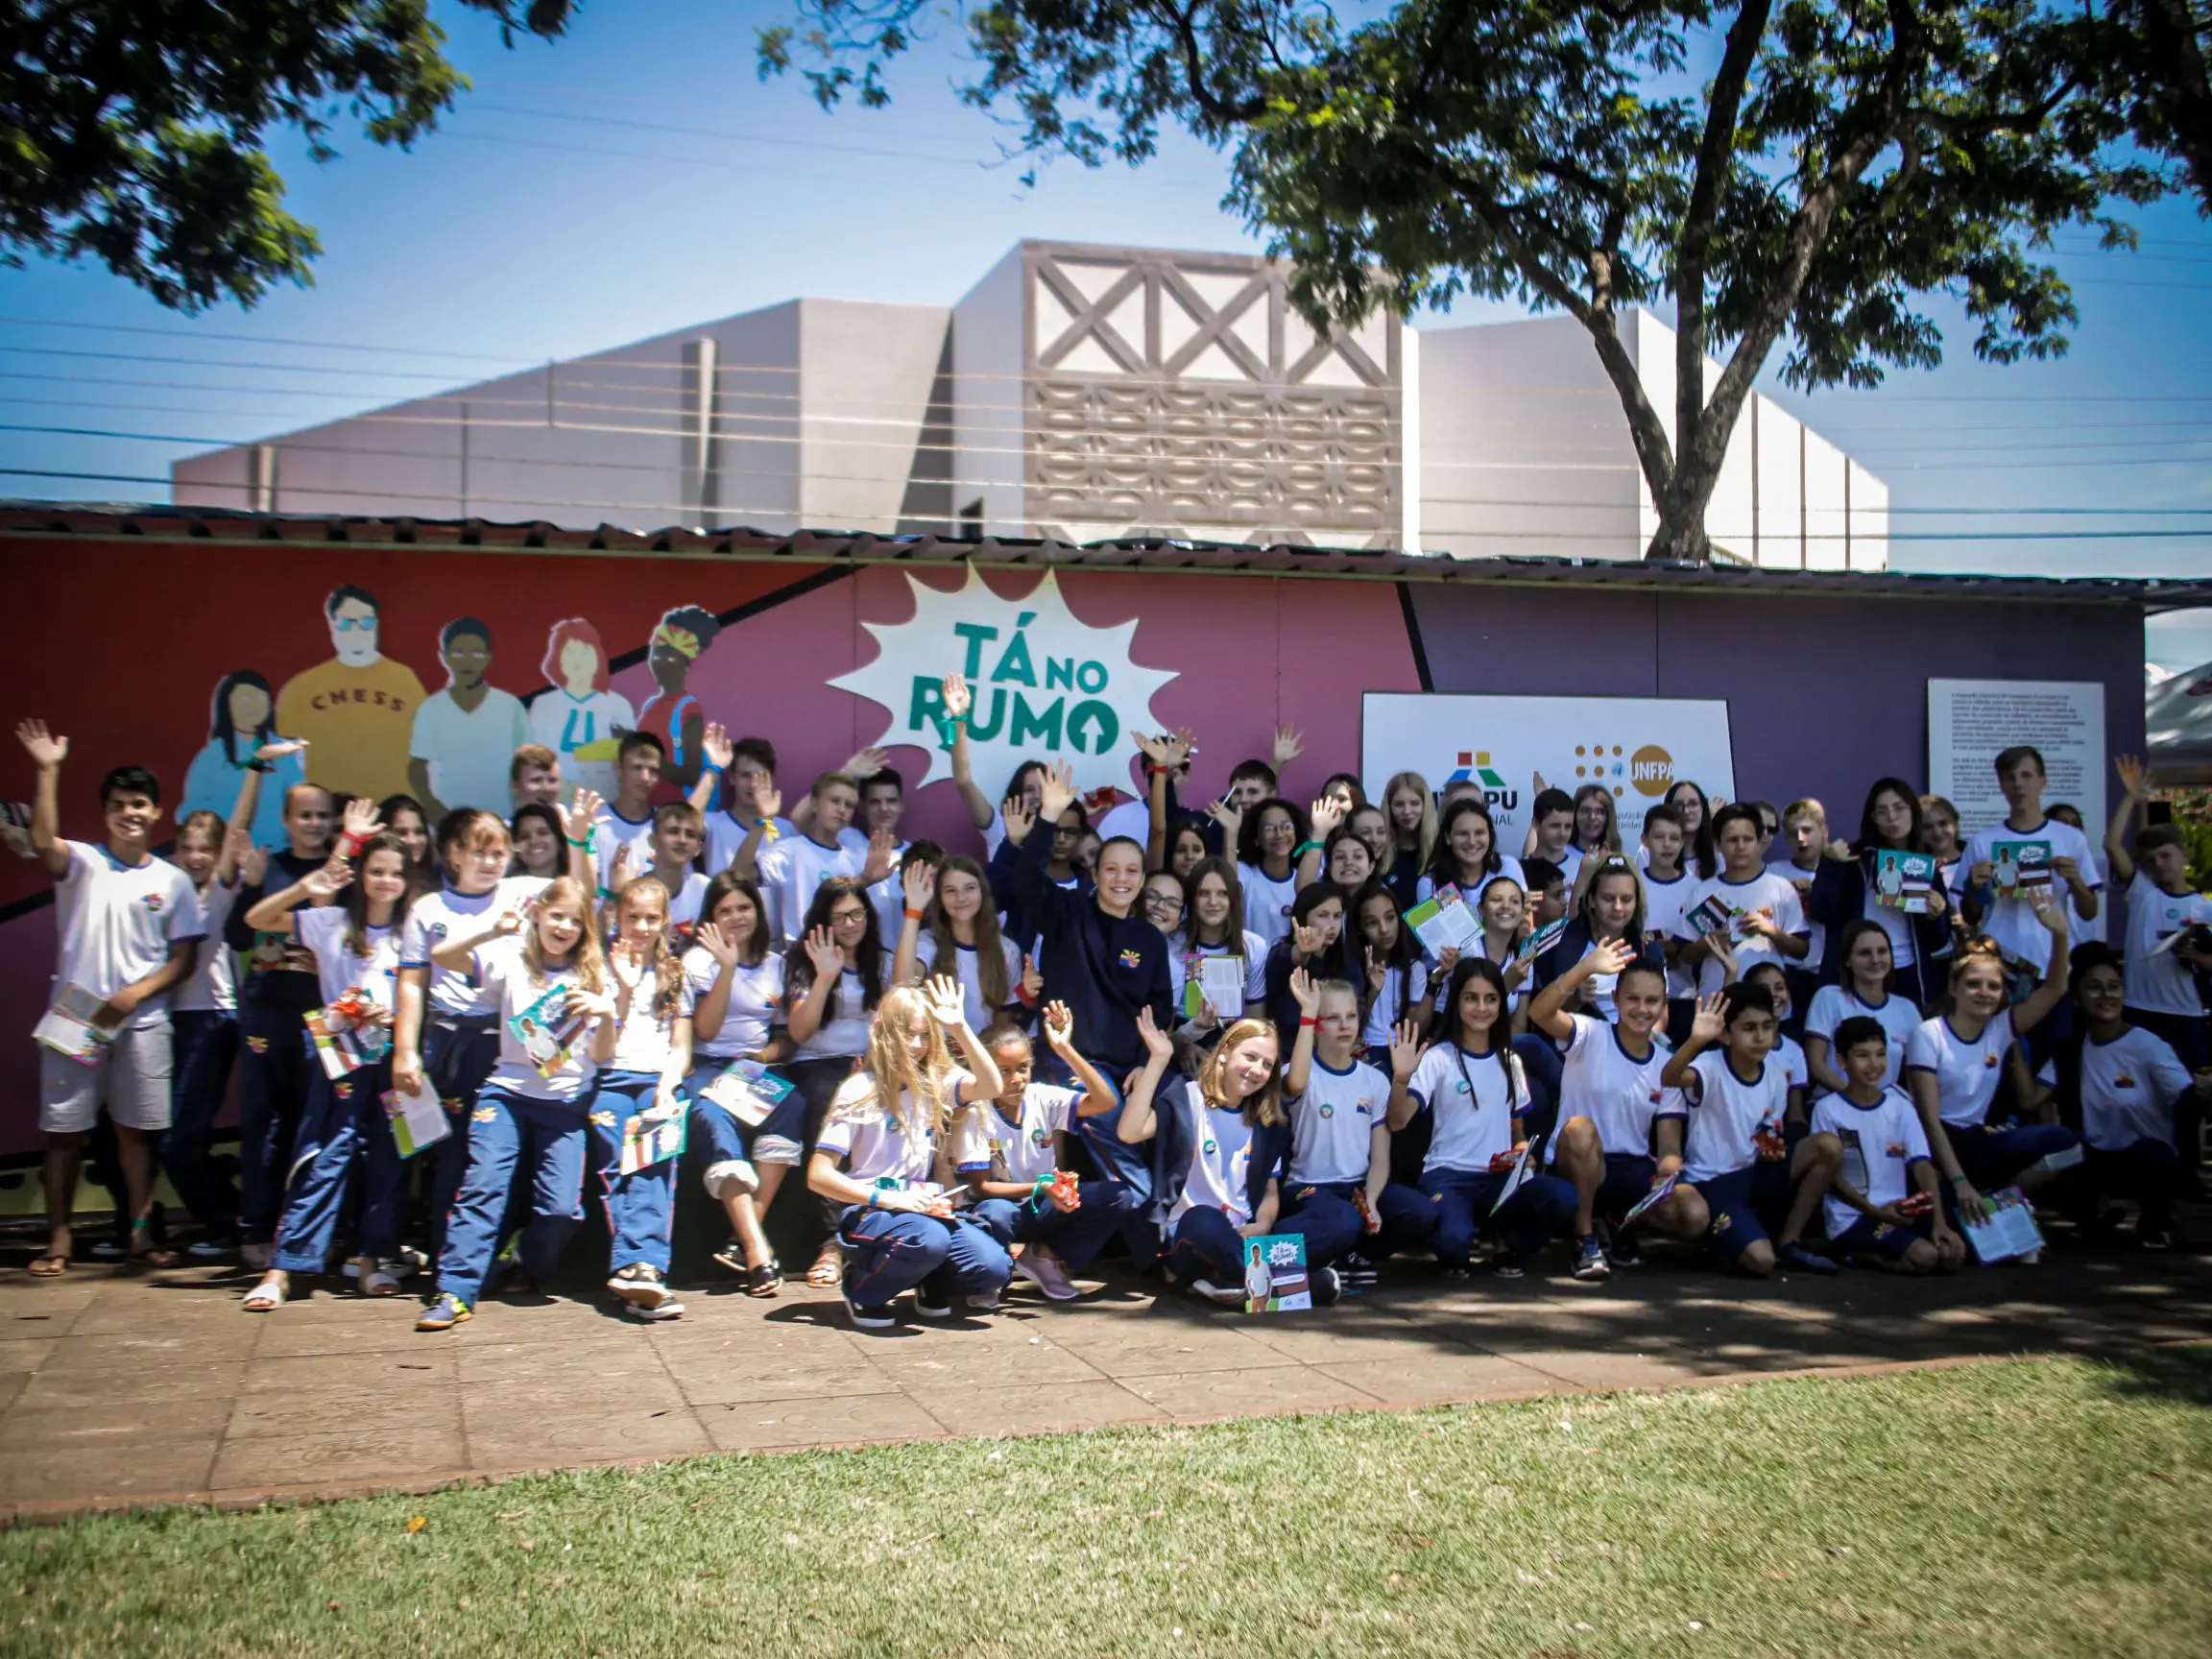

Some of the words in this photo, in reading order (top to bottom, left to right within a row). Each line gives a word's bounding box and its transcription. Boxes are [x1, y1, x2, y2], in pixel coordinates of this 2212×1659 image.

[954, 612, 1038, 687] TÁ
[1046, 656, 1109, 694] NO
[908, 675, 1119, 756] RUMO
[1630, 760, 1674, 781] UNFPA
